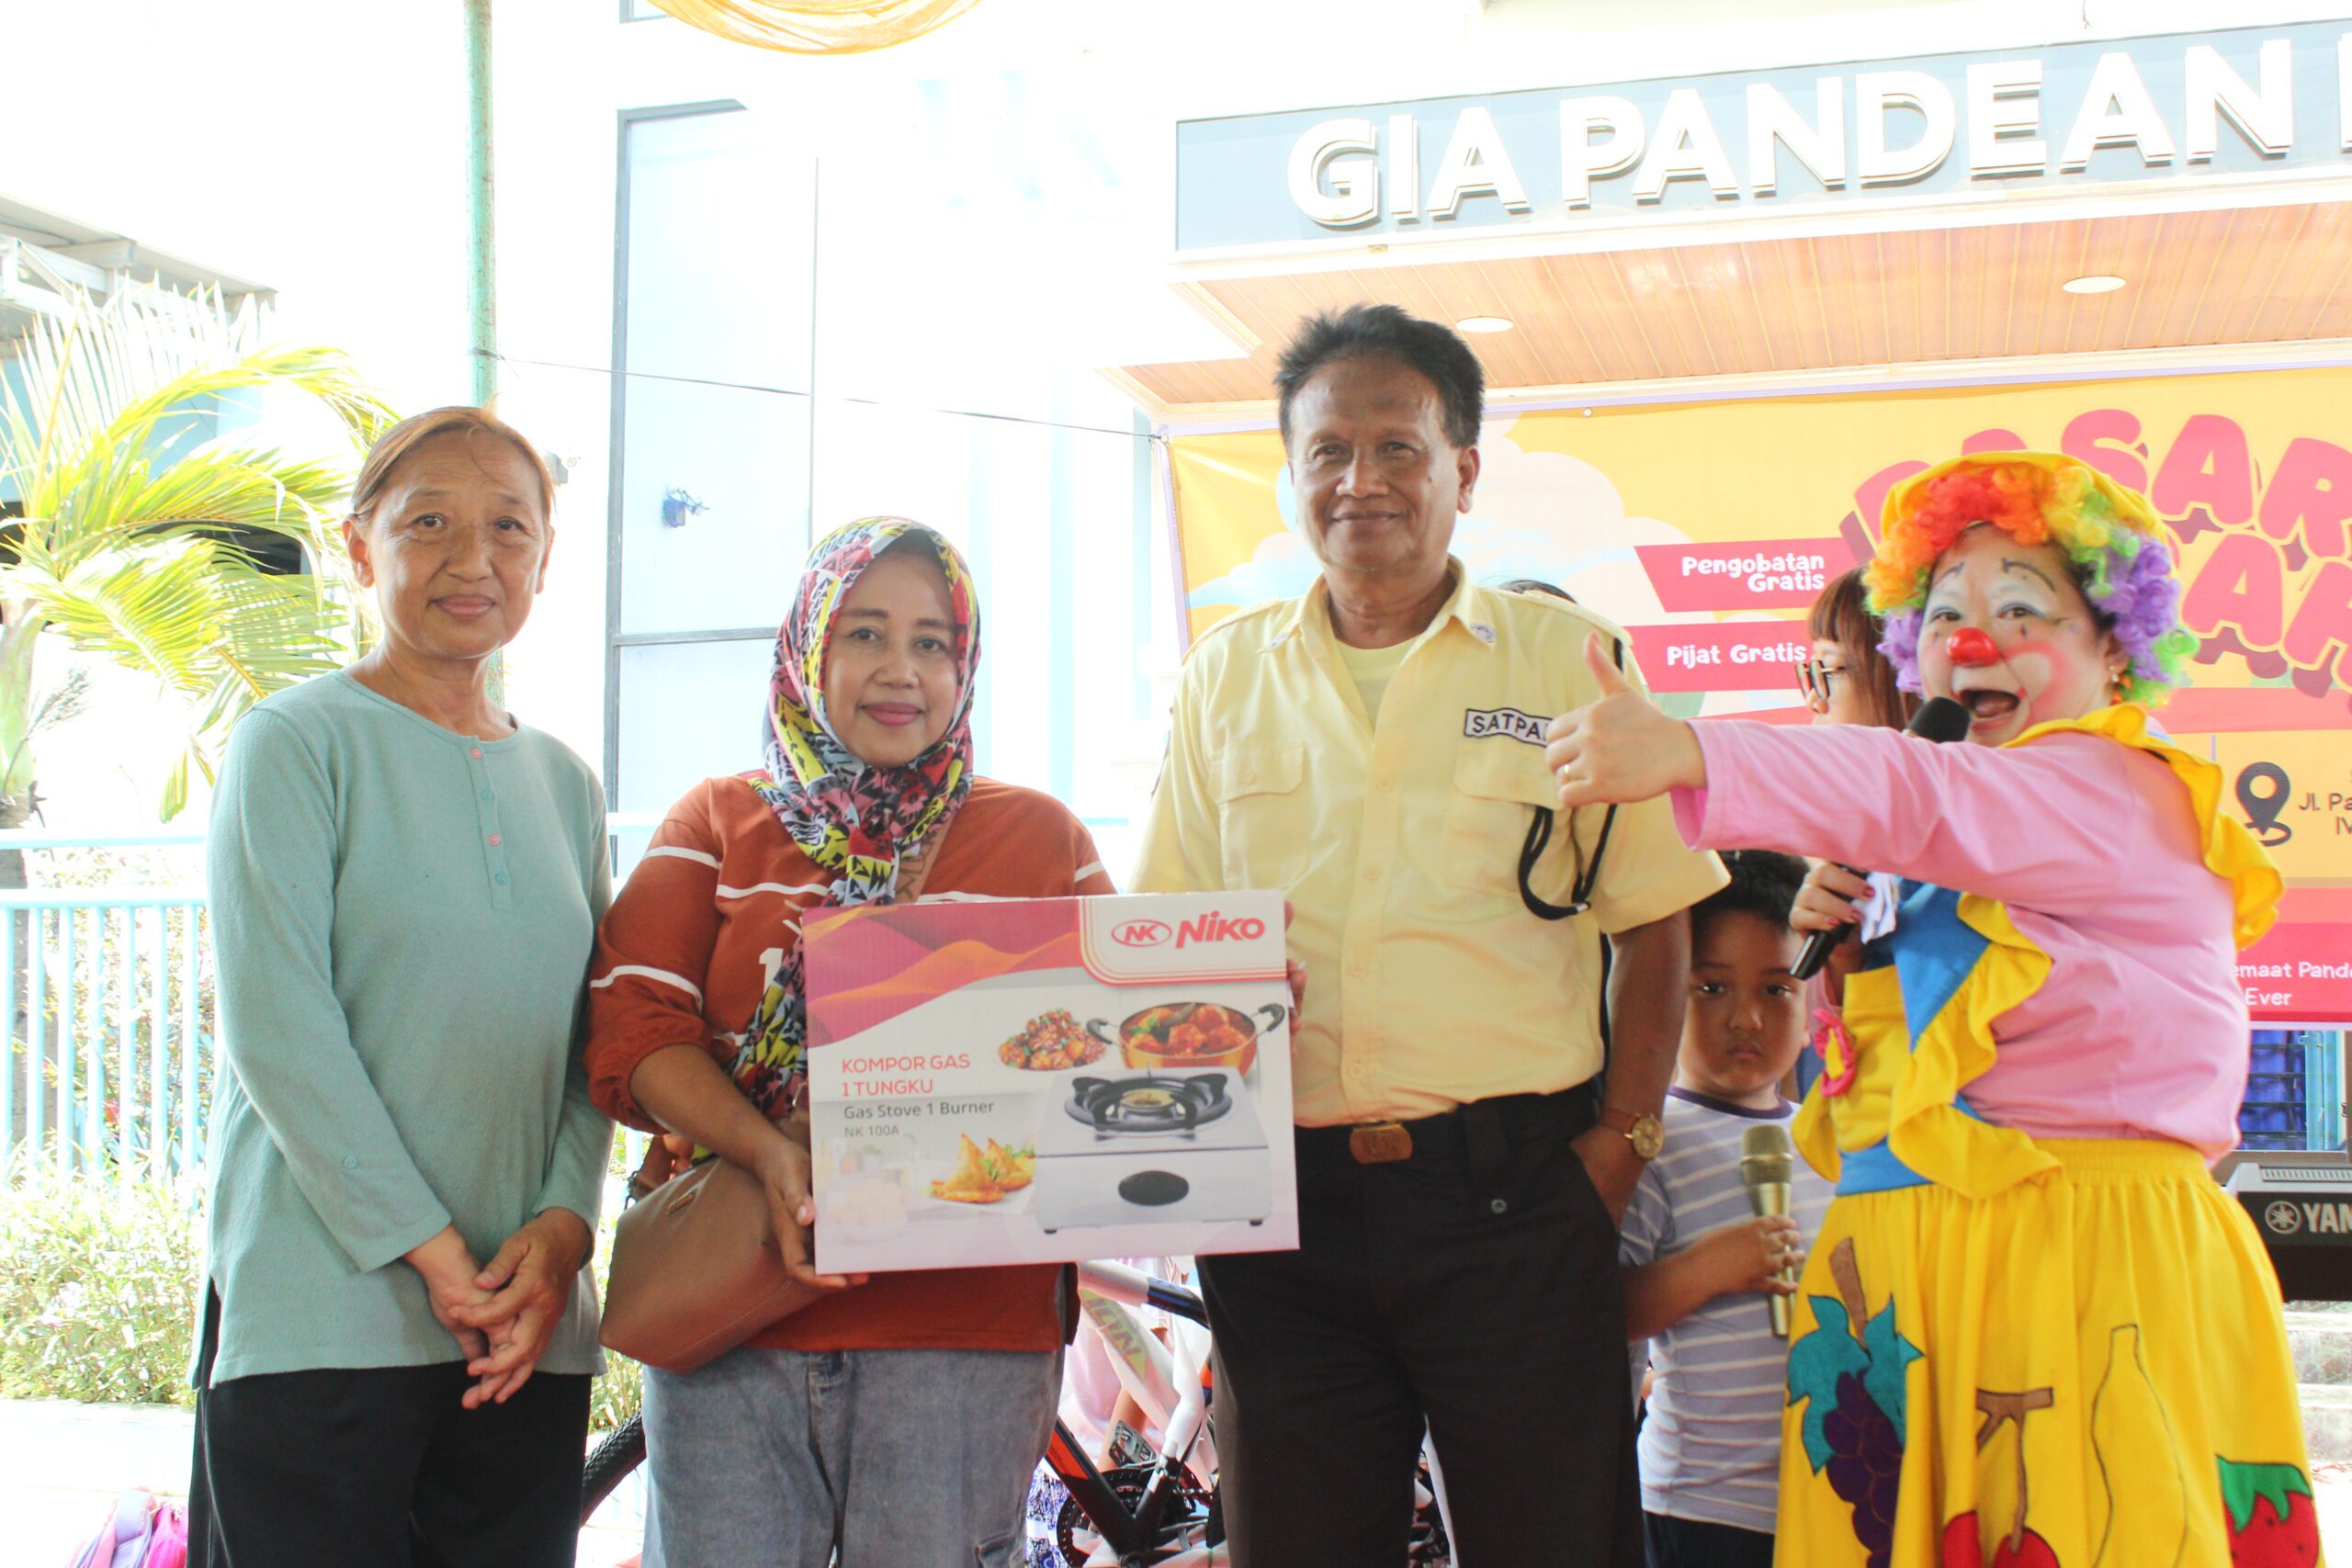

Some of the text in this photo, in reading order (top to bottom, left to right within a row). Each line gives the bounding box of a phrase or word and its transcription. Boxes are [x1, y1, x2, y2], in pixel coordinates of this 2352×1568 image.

[1287, 106, 1532, 227] GIA
[1558, 39, 2294, 206] PANDEAN
[1681, 553, 1825, 578] Pengobatan
[1747, 570, 1825, 592] Gratis
[1667, 642, 1807, 669] Pijat Gratis
[1472, 713, 1549, 741] SATPA
[1124, 924, 1159, 942] NK
[2298, 961, 2352, 978] Pand
[2245, 987, 2292, 1006] Ever
[842, 1054, 971, 1074] KOMPOR GAS
[842, 1078, 934, 1098] 1 TUNGKU
[843, 1101, 995, 1120] Gas Stove 1 Burner
[844, 1124, 900, 1138] NK 100A
